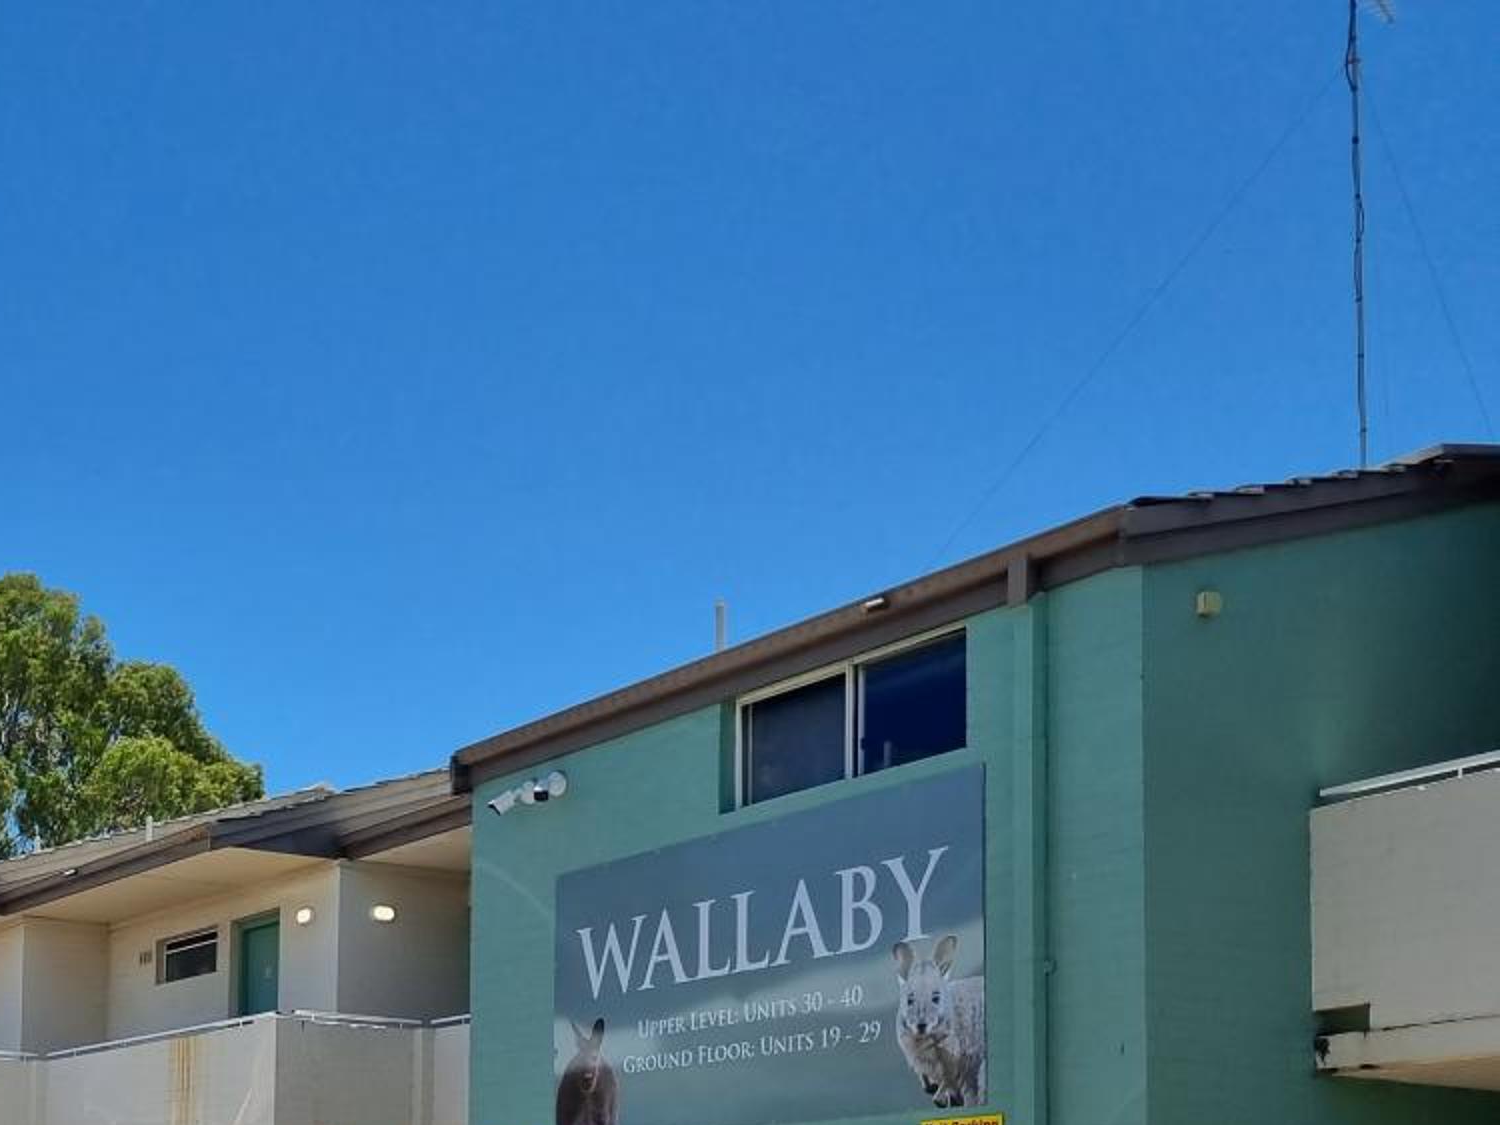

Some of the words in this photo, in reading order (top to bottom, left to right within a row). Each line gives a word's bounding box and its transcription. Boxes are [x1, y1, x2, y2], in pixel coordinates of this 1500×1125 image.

[576, 846, 949, 1000] WALLABY
[637, 1016, 687, 1039] UPPER
[691, 1009, 739, 1032] LEVEL:
[743, 998, 796, 1023] UNITS
[802, 991, 823, 1013] 30
[840, 984, 863, 1007] 40
[623, 1049, 693, 1073] GROUND
[698, 1042, 755, 1065] FLOOR:
[760, 1032, 814, 1056] UNITS
[820, 1025, 841, 1047] 19
[859, 1020, 881, 1043] 29
